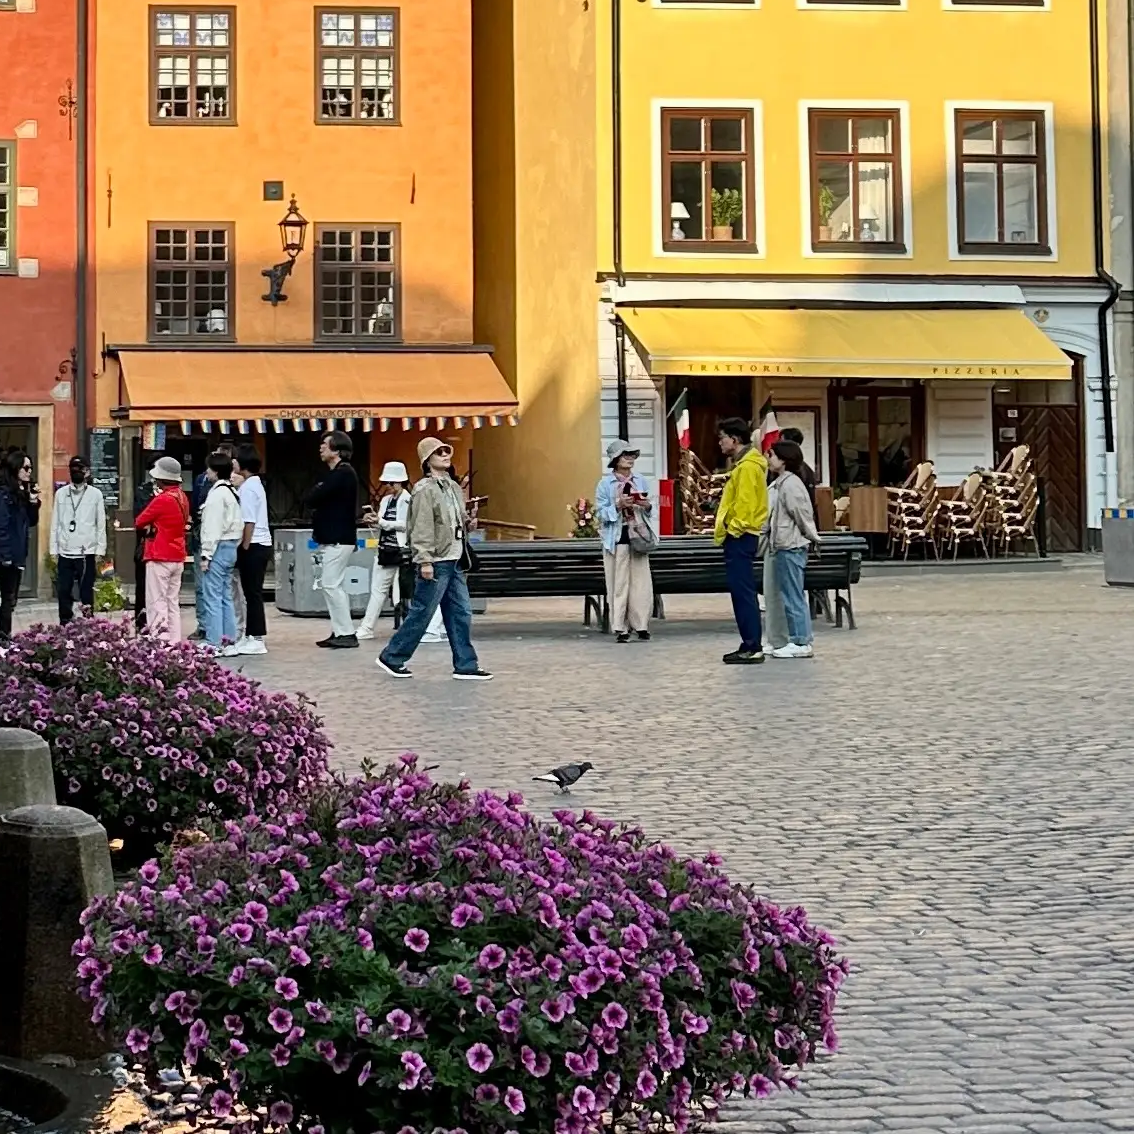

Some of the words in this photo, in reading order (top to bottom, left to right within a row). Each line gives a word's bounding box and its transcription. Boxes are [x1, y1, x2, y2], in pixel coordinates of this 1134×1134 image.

[687, 364, 793, 373] TRATTORIA
[932, 367, 1020, 375] PIZZERIA
[279, 409, 372, 418] CHOKLADKOPPEN
